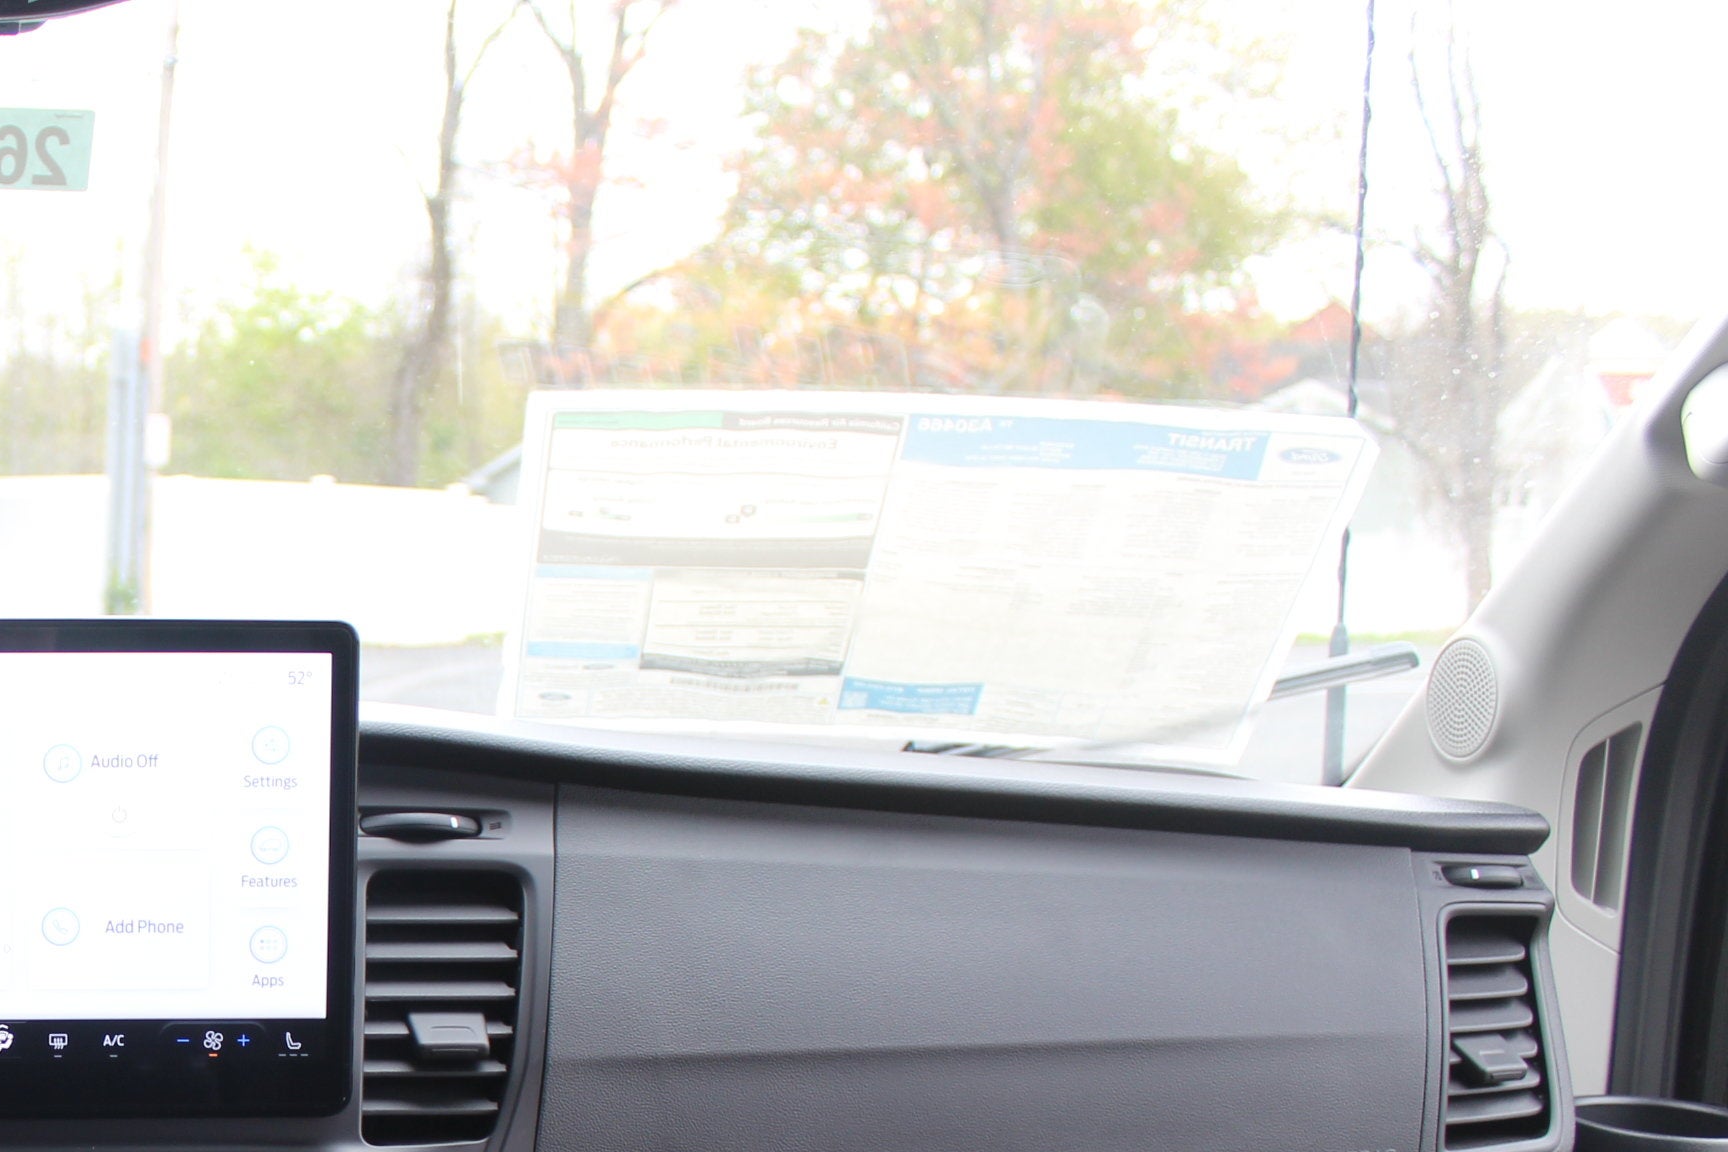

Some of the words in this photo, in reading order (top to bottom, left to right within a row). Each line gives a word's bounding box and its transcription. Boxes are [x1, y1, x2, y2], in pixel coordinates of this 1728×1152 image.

[90, 754, 134, 769] Audio
[136, 753, 159, 769] Off
[243, 774, 299, 791] Settings
[240, 874, 299, 889] Features
[104, 919, 135, 935] Add
[137, 919, 185, 934] Phone
[251, 973, 285, 989] Apps
[102, 1034, 125, 1048] A/C
